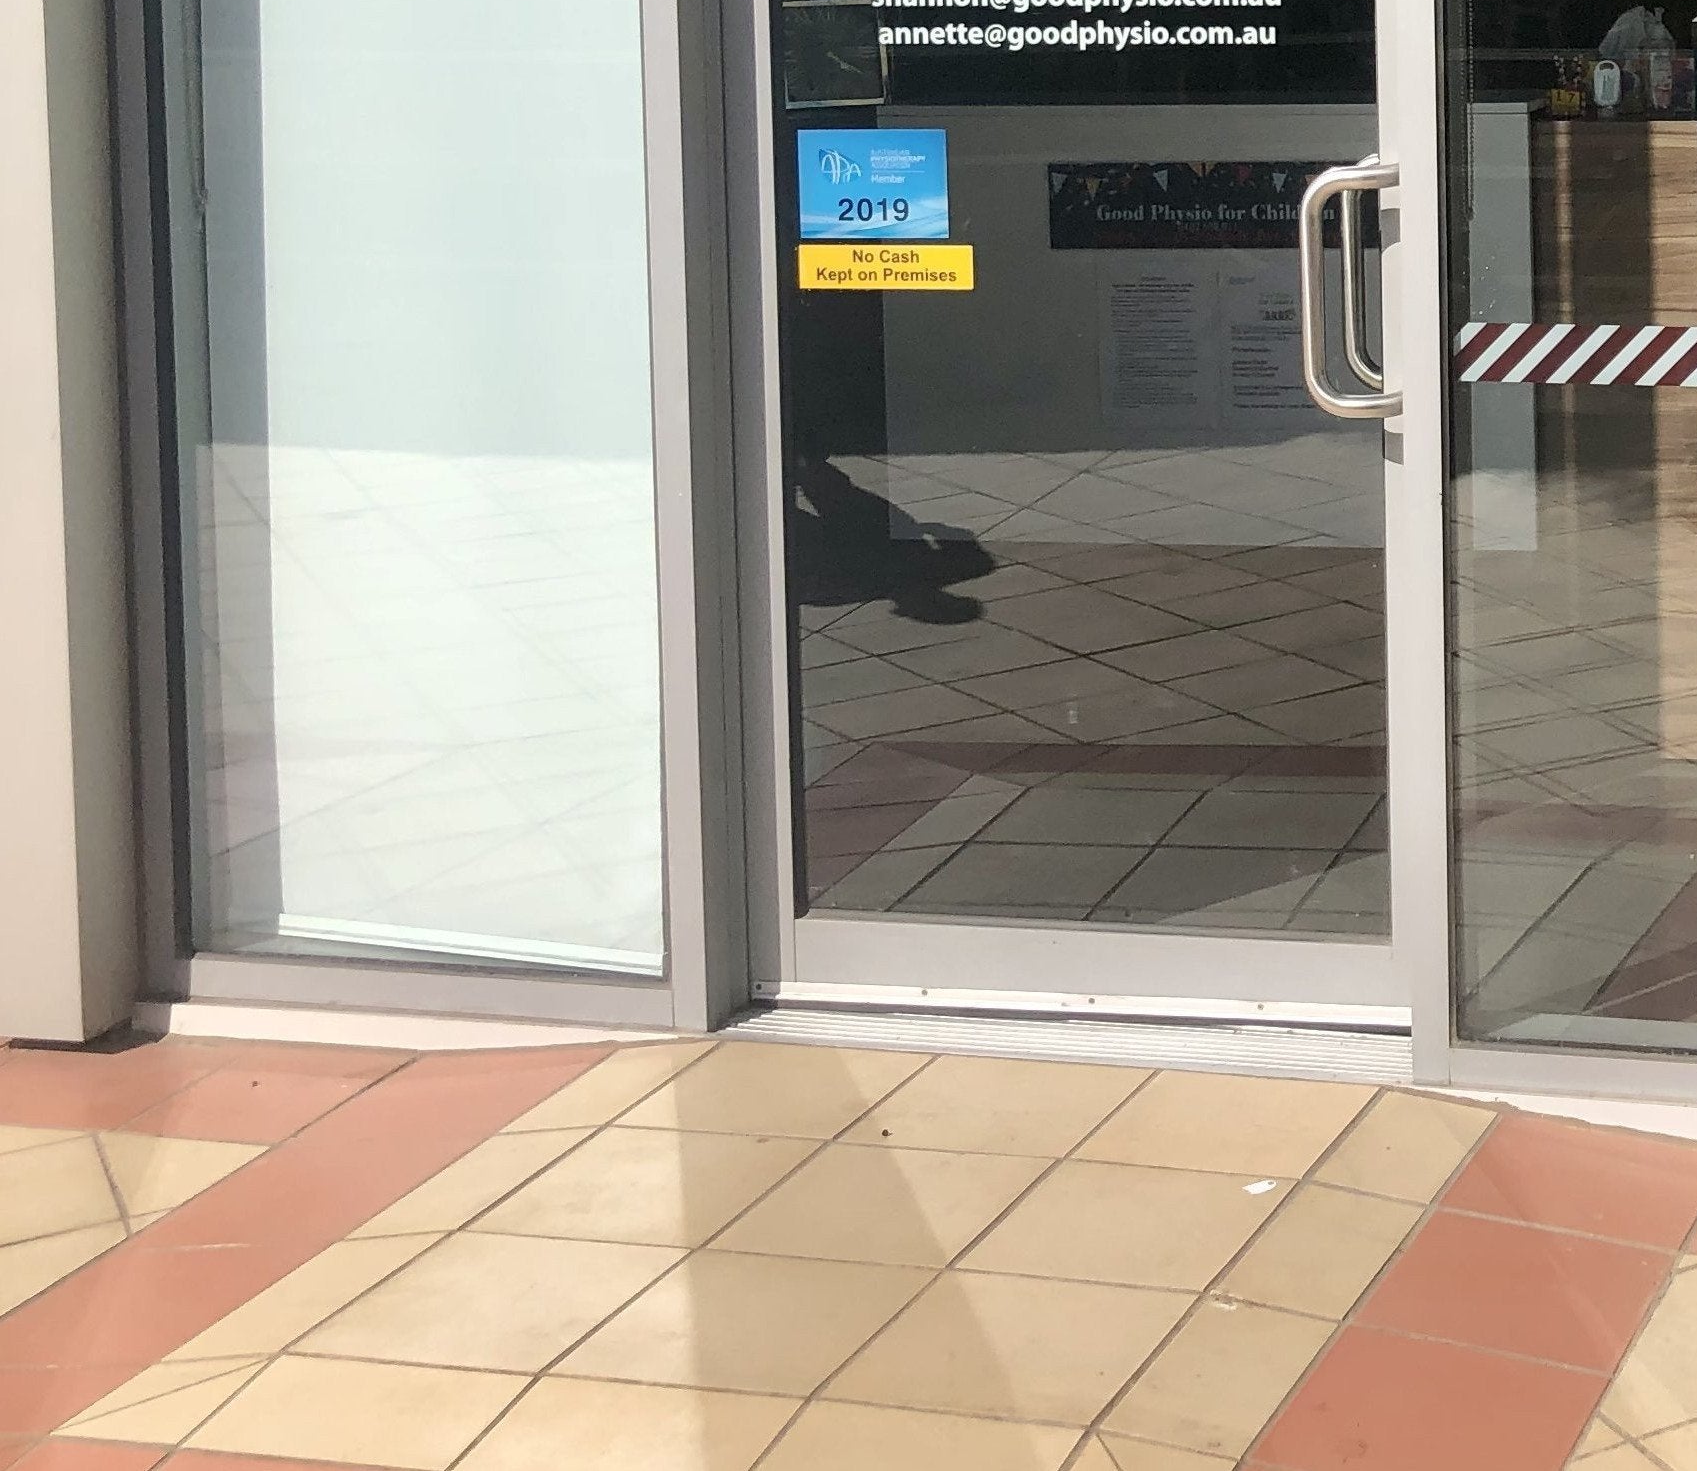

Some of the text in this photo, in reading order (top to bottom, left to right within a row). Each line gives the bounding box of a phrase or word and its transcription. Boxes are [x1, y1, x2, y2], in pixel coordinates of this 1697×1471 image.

[878, 19, 1277, 53] annette@goodphysio.com.au
[838, 197, 910, 222] 2019
[1096, 204, 1145, 221] Good
[1150, 204, 1213, 226] Physio
[1217, 204, 1247, 221] for
[852, 249, 920, 264] No Cash
[816, 267, 958, 285] Kept on Premises
